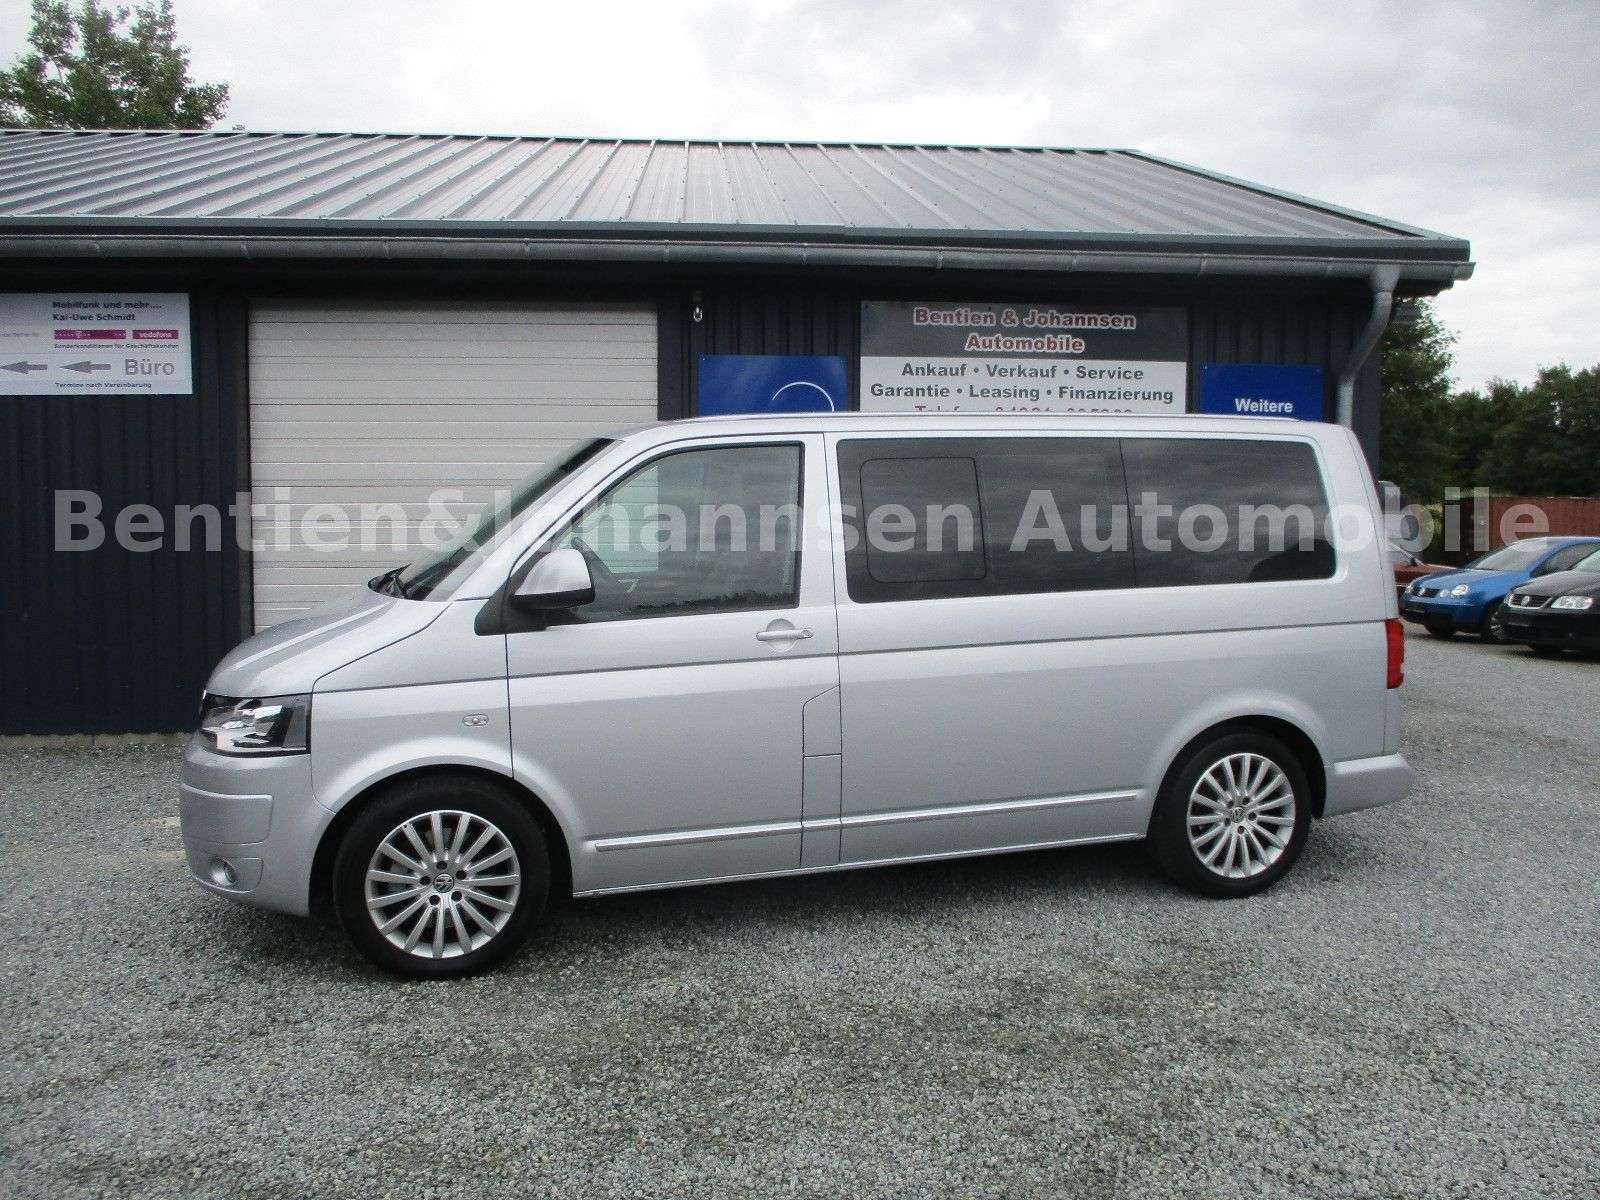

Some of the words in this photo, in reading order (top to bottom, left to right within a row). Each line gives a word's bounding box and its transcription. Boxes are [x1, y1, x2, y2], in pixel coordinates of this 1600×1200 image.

[53, 301, 101, 309] Mobilfunk
[103, 301, 122, 309] und
[53, 313, 94, 321] Kai-Uwe
[96, 313, 136, 321] Schmidt
[914, 307, 997, 327] Bentien
[1001, 308, 1019, 328] &
[1023, 309, 1137, 330] Johannsen
[139, 331, 173, 339] vodafone
[964, 332, 1086, 354] Automobile
[124, 358, 175, 376] Büro
[902, 362, 967, 377] Ankauf
[986, 364, 1058, 378] Verkauf
[1076, 366, 1144, 380] Service
[870, 383, 950, 398] Garantie
[969, 385, 1040, 402] Leasing
[1059, 386, 1174, 404] Finanzierung
[1234, 398, 1294, 413] Weitere
